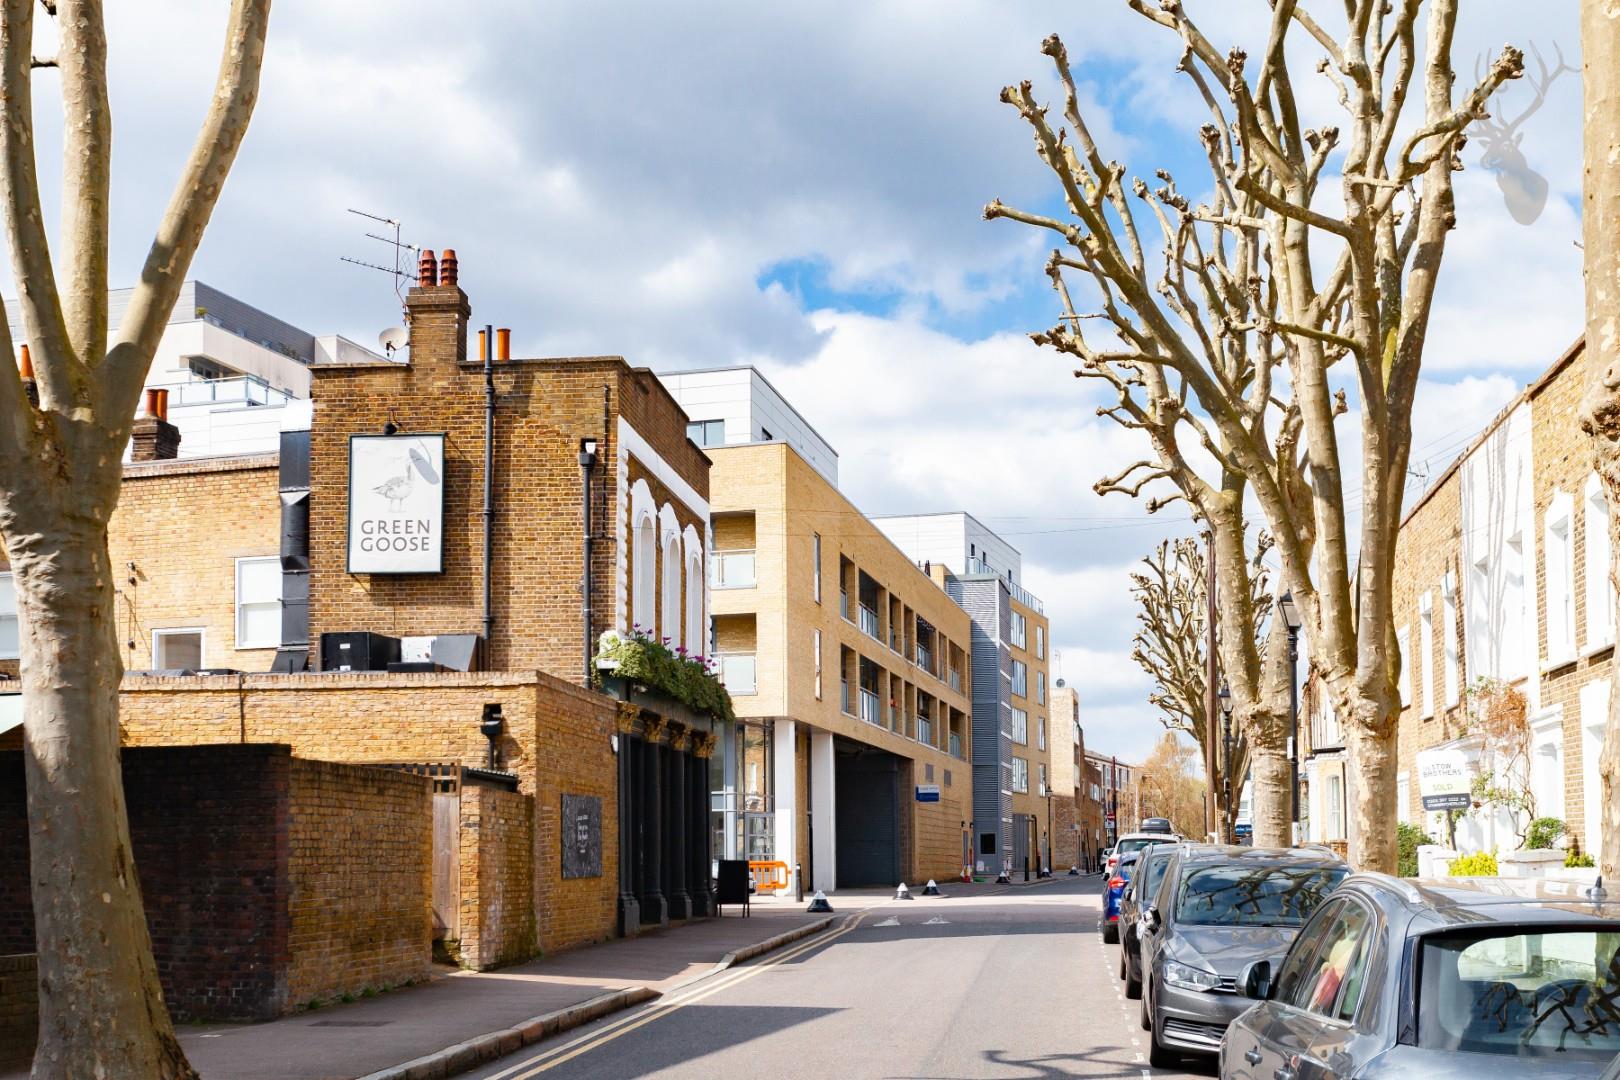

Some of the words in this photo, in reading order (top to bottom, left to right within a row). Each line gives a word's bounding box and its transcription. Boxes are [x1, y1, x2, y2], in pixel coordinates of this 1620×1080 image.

[361, 519, 430, 534] GREEN
[360, 536, 430, 551] GOOSE
[1423, 769, 1462, 778] BROTHERS
